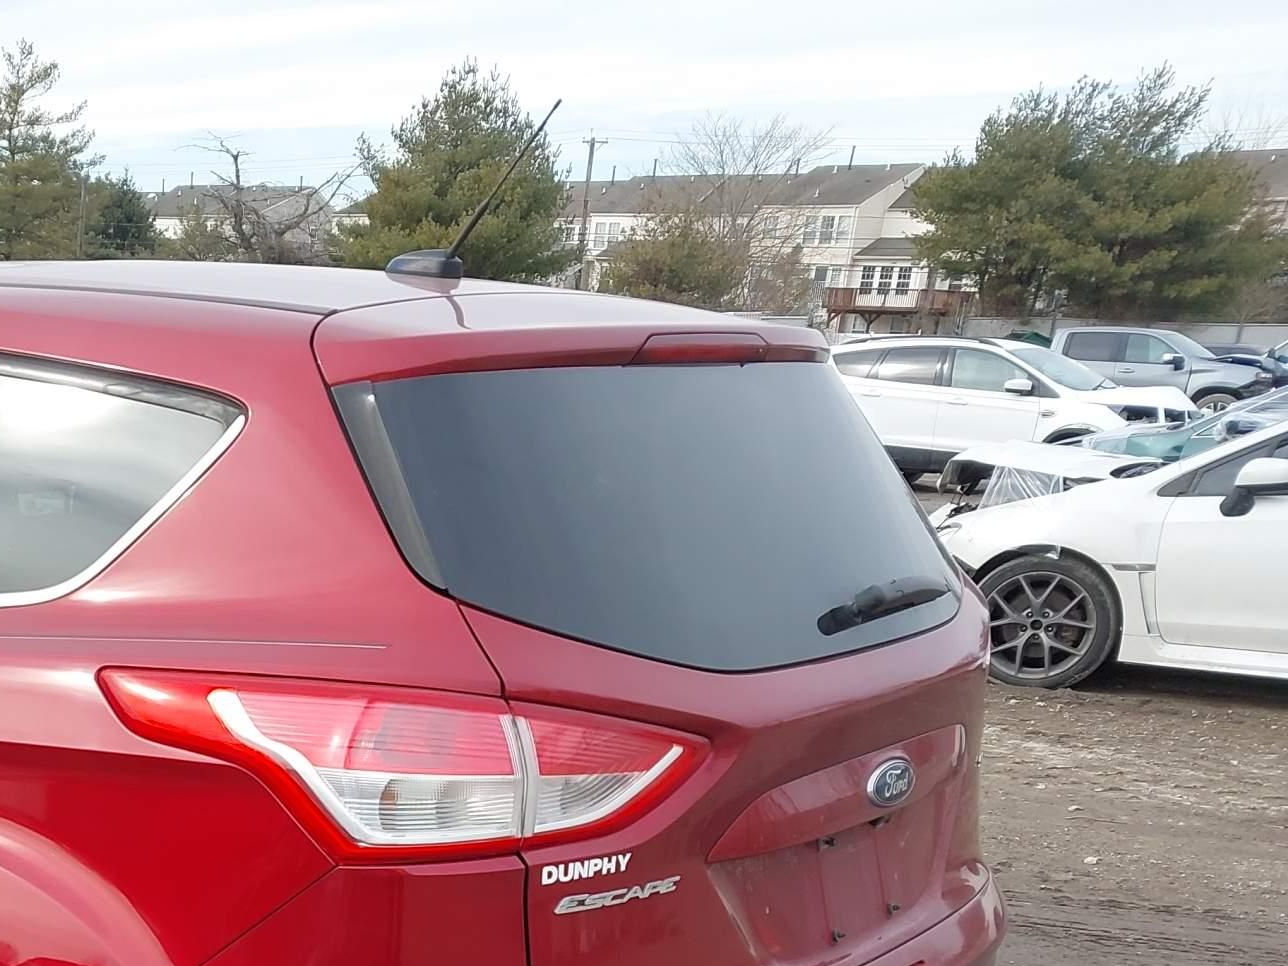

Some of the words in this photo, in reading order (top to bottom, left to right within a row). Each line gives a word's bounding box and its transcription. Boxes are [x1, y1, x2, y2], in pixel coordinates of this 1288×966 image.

[884, 769, 910, 798] Ford
[541, 853, 632, 886] DUNPHY
[553, 875, 682, 915] ESCAPE
